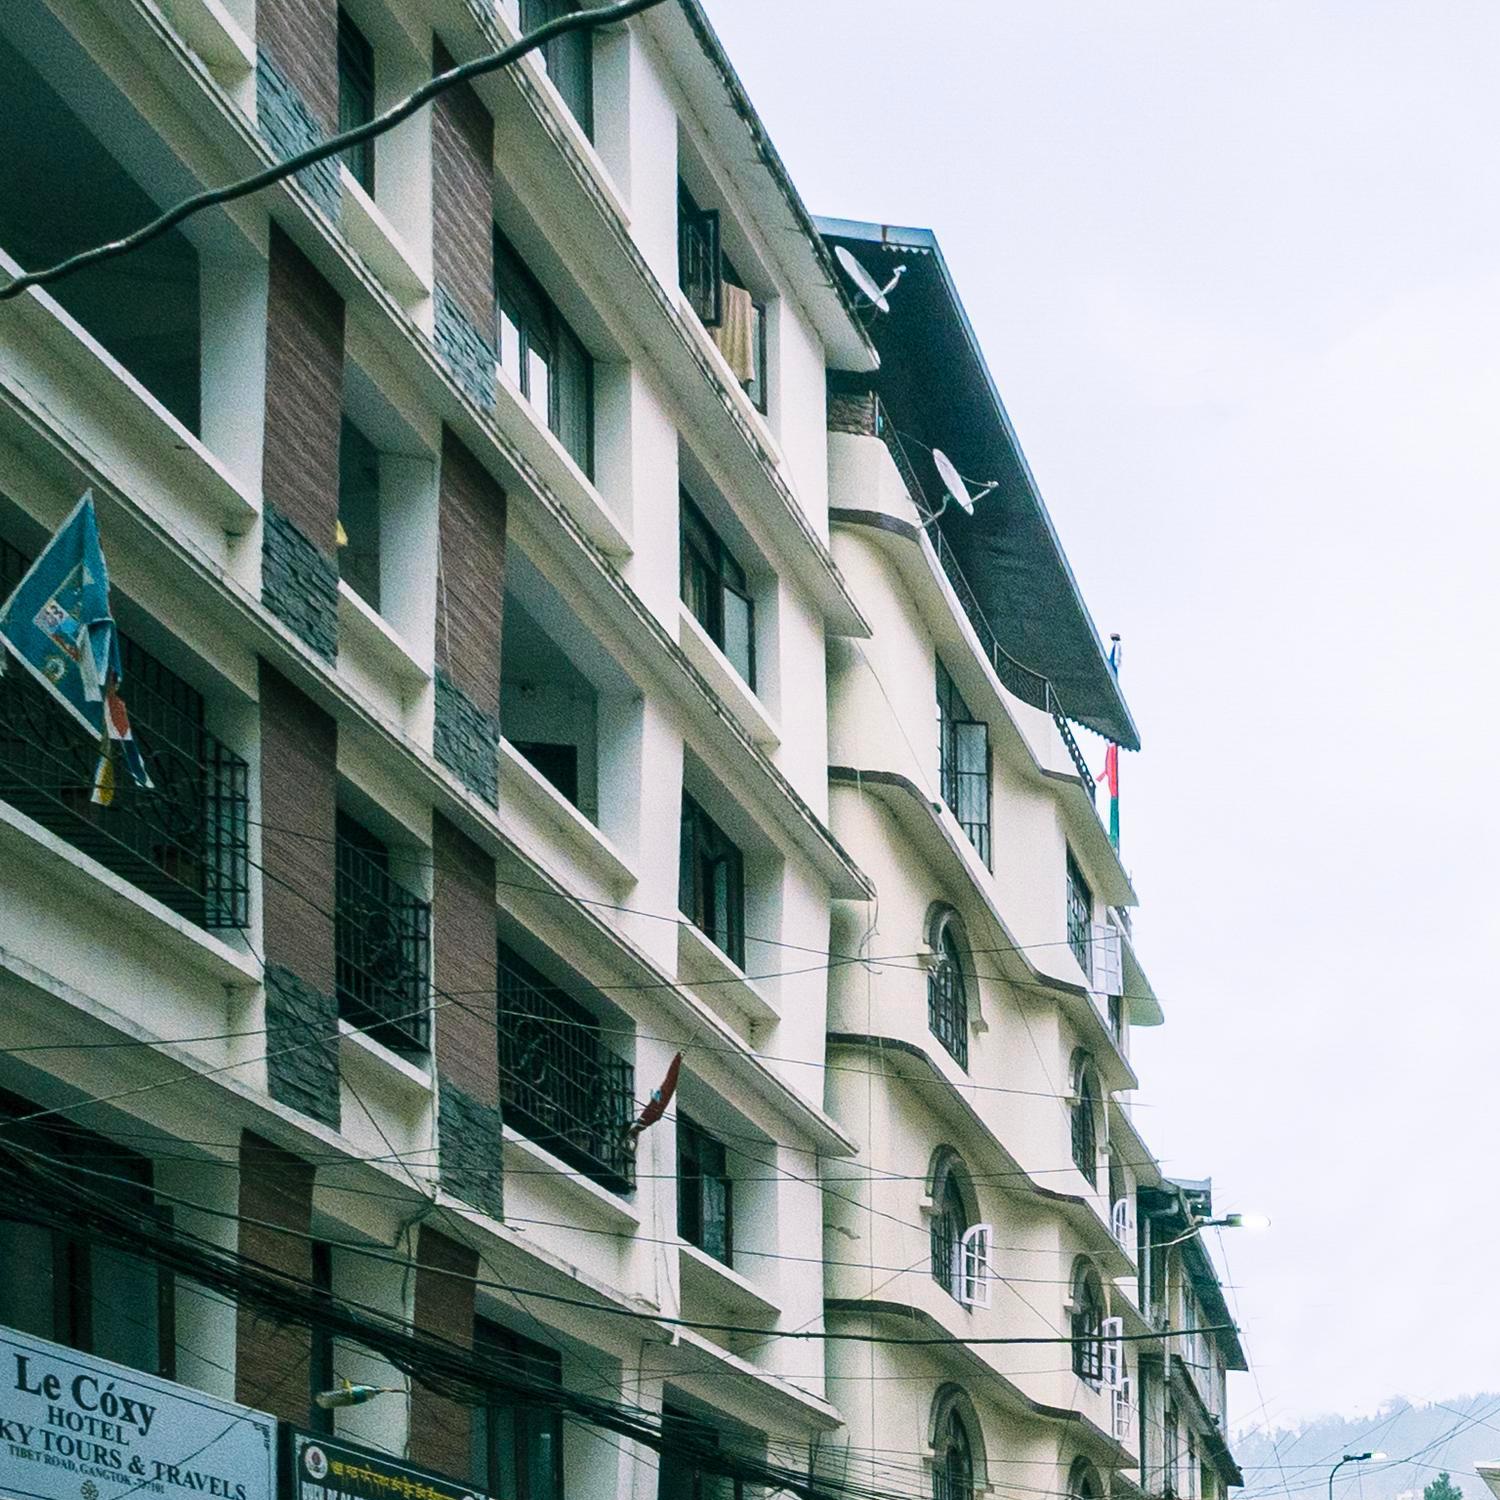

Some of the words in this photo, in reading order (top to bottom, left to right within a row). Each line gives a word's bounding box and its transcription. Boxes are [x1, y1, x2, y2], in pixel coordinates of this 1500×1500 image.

[13, 1353, 61, 1401] Le
[72, 1375, 157, 1436] Cóxy
[48, 1405, 129, 1446] HOTEL
[8, 1444, 41, 1462] TIBET
[80, 1463, 132, 1486] GANGTOK
[40, 1429, 122, 1470] TOURS
[128, 1455, 146, 1475] &
